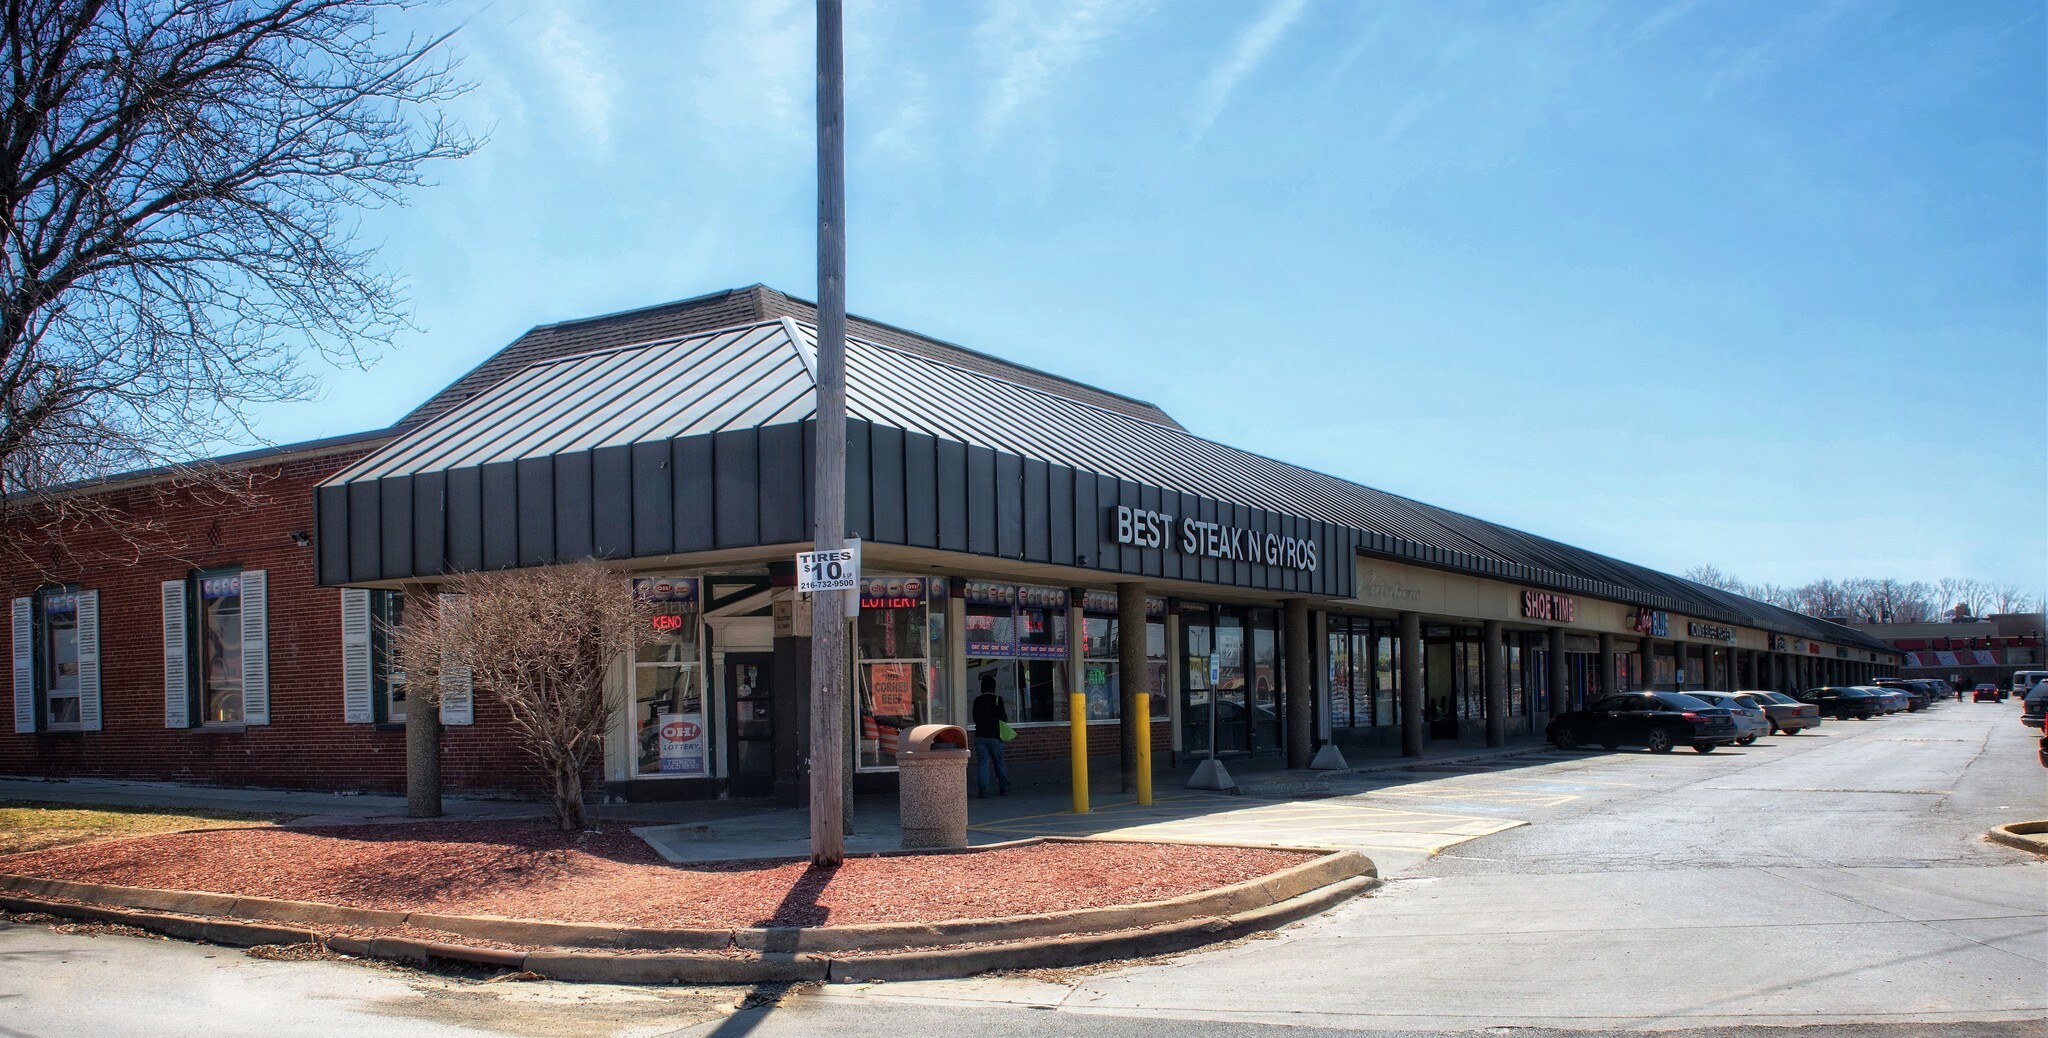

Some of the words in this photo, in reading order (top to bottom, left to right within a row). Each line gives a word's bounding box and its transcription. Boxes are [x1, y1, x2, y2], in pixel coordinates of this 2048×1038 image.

[1117, 505, 1172, 549] BEST
[1183, 518, 1243, 560] STEAK
[1248, 530, 1261, 562] N
[1265, 533, 1317, 571] GYROS
[800, 552, 851, 563] TIRES
[801, 580, 854, 589] 216-732-9500
[1525, 591, 1551, 620] SHOE
[1553, 596, 1574, 622] TIME
[653, 615, 682, 629] KENO
[875, 681, 908, 693] CORNED
[882, 694, 903, 704] BEEF
[663, 725, 697, 737] OH!
[664, 743, 700, 751] LOTTERY
